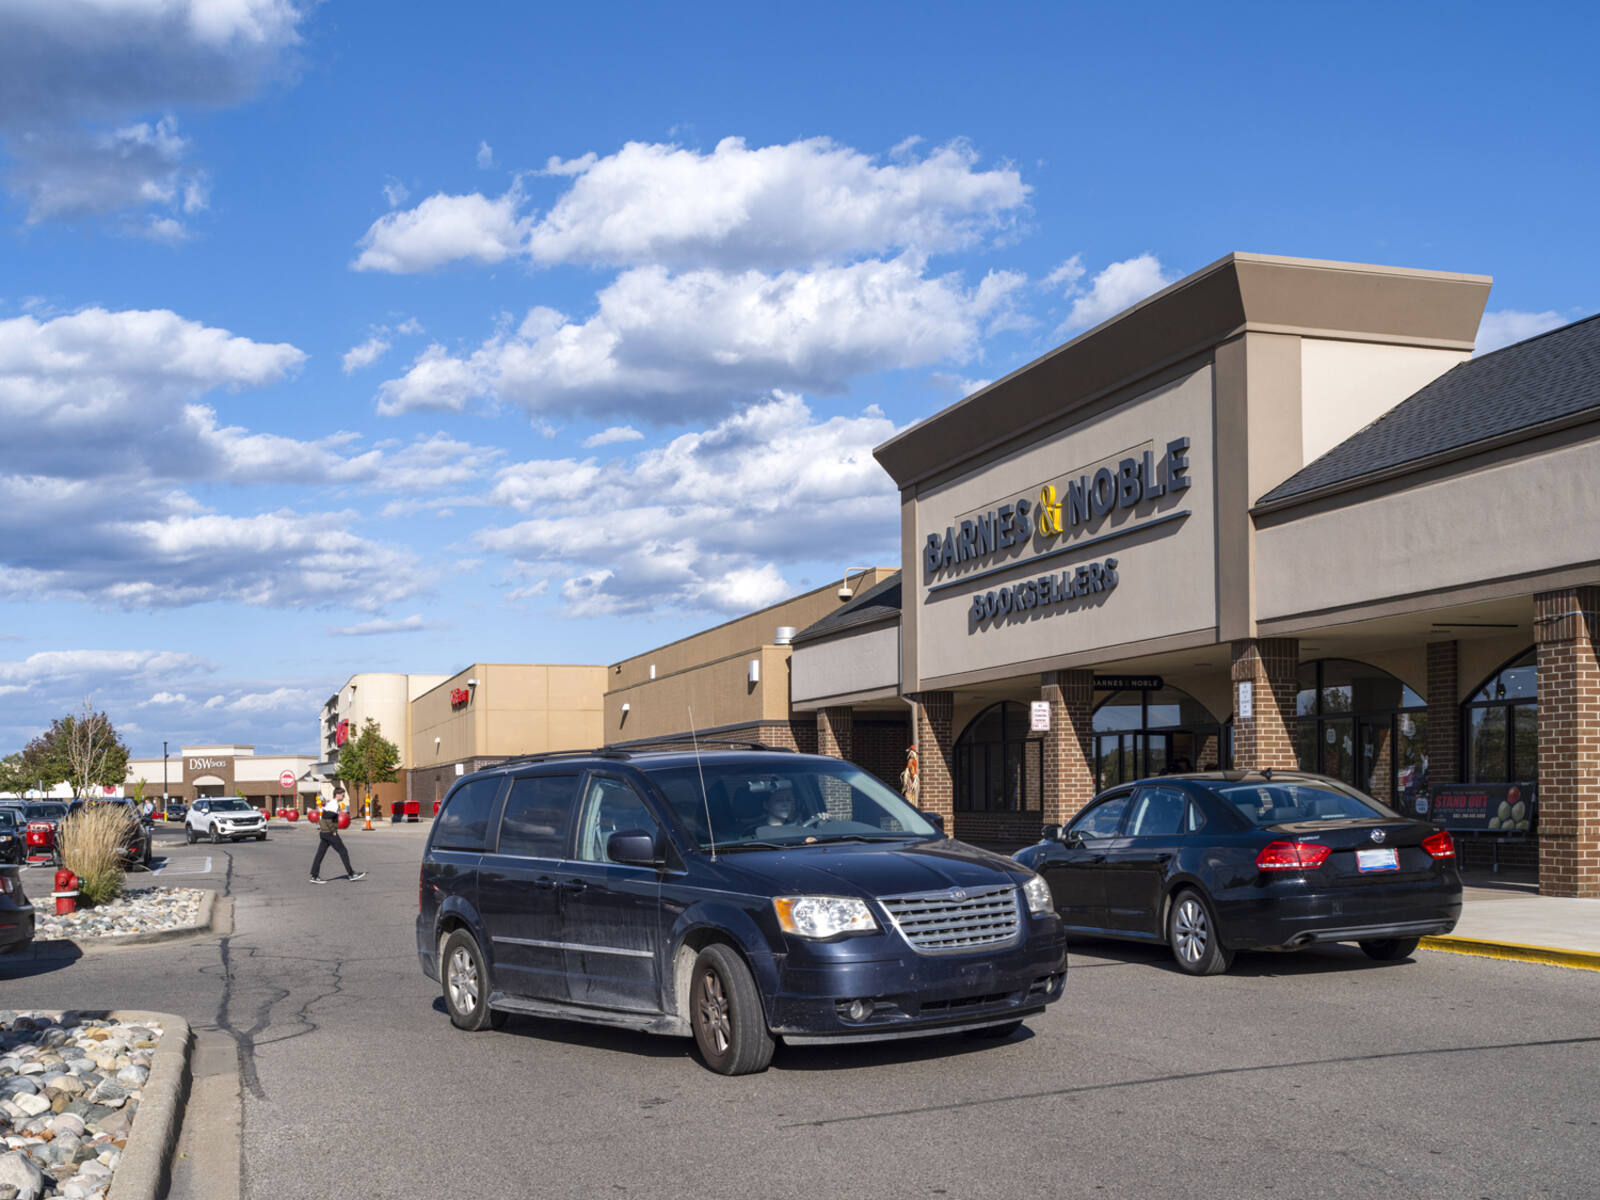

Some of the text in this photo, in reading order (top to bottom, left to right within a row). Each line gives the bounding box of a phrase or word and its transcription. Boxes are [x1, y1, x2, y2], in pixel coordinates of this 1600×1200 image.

[926, 437, 1192, 573] BARNES & NOBLE
[973, 558, 1119, 621] BOOKSELLERS
[189, 757, 211, 769] DSW
[1435, 795, 1466, 808] STAND
[1468, 795, 1488, 808] OUT
